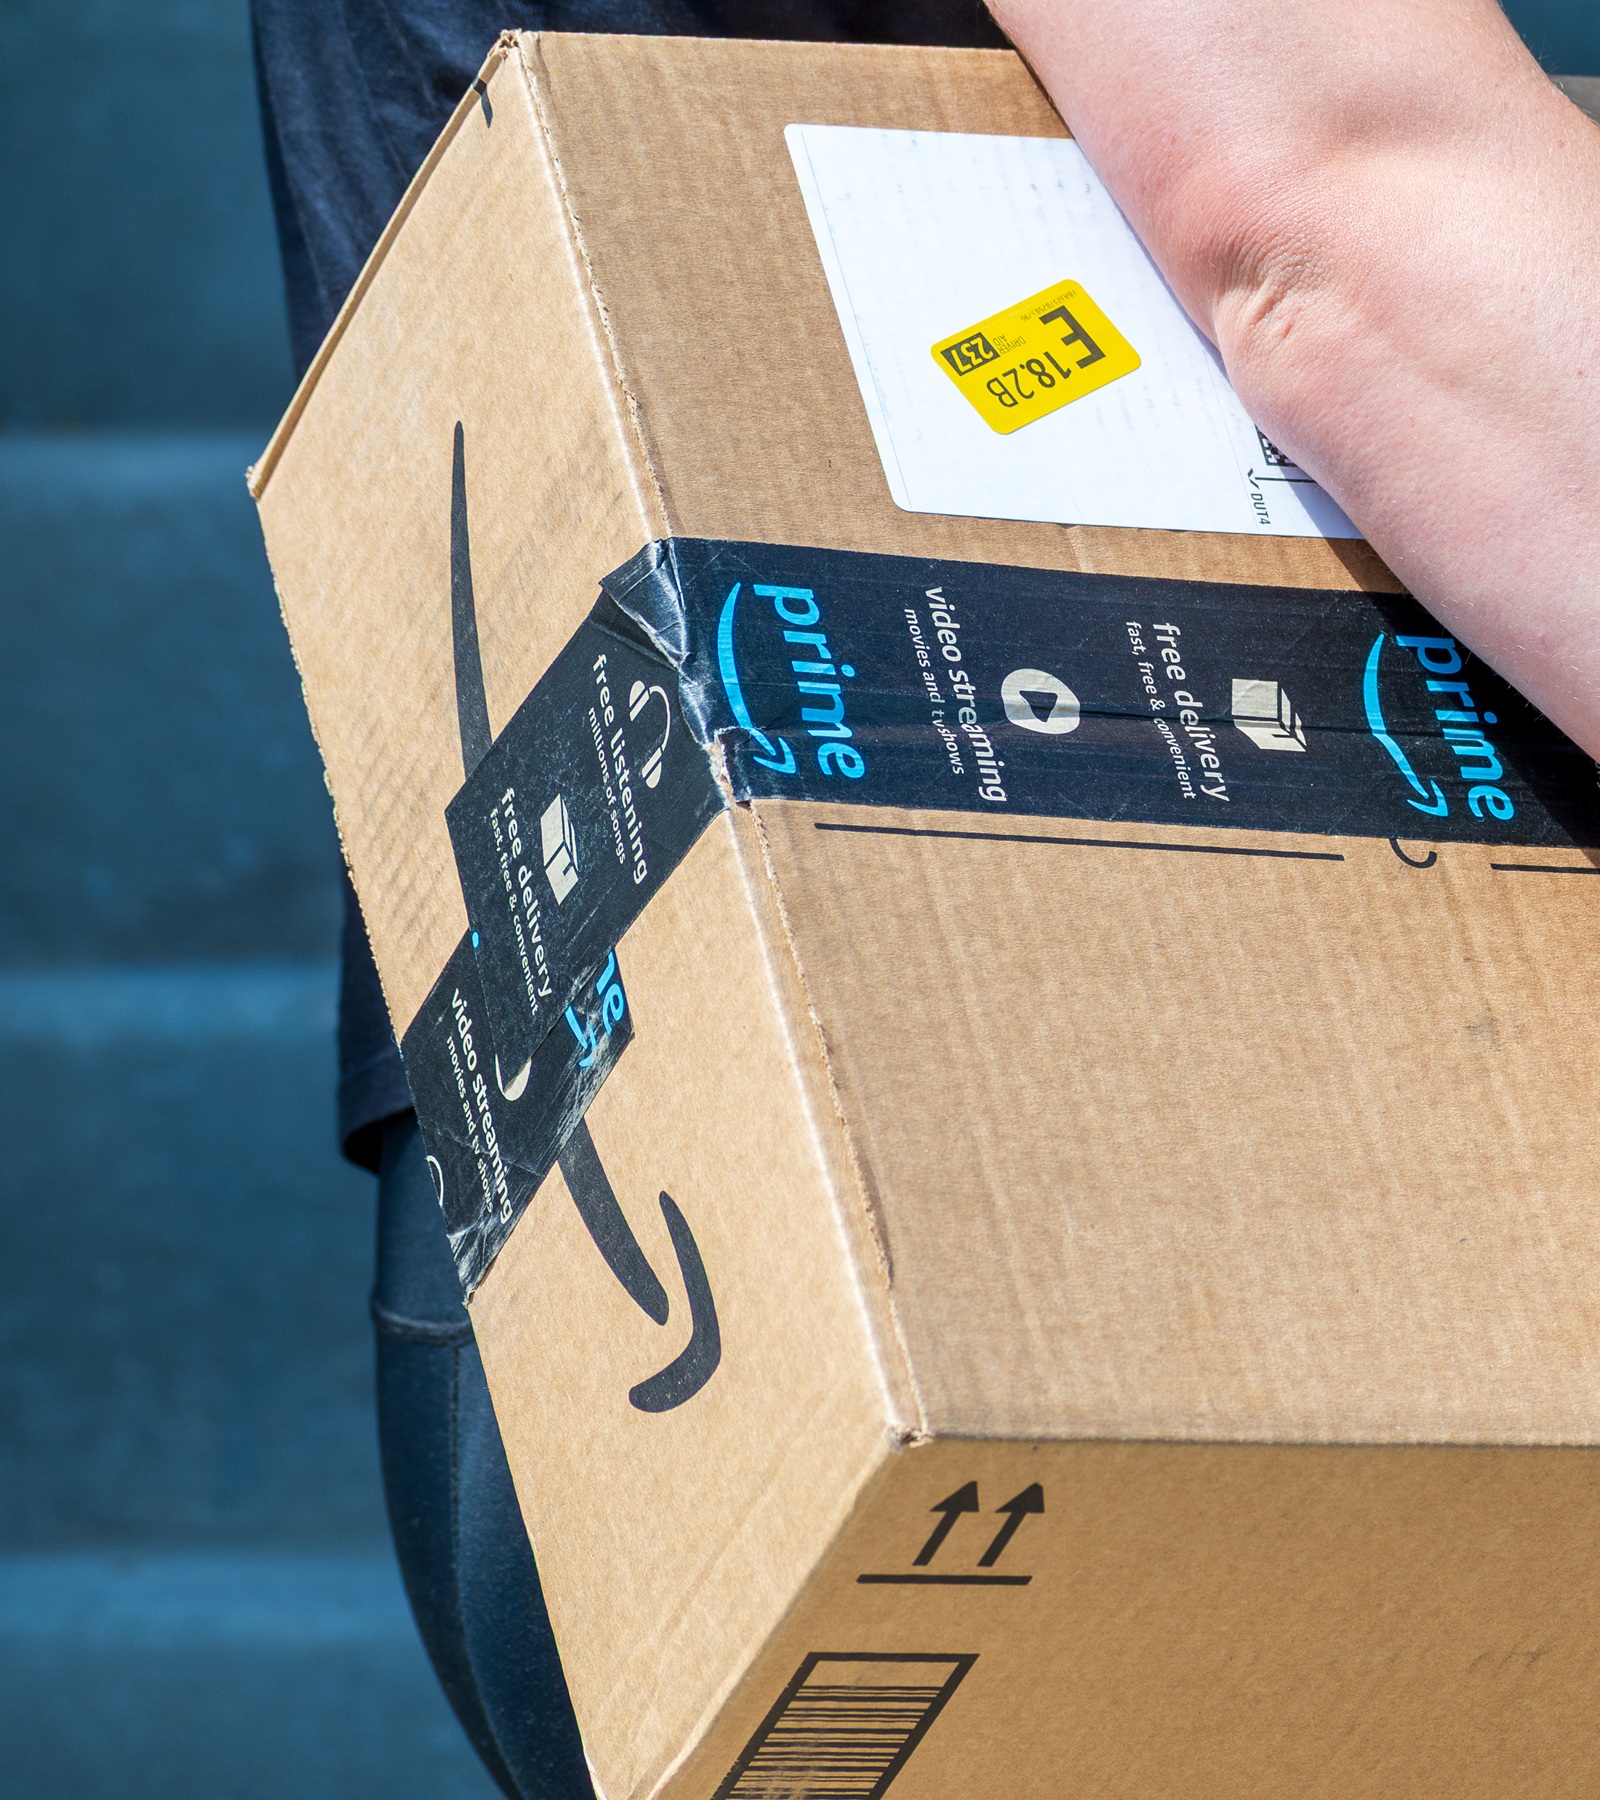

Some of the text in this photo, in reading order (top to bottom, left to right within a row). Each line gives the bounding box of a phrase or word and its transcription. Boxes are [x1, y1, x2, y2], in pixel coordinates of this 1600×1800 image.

[950, 336, 994, 373] 237
[986, 351, 1072, 408] 18.2B
[992, 334, 1006, 346] AID
[999, 336, 1027, 355] DRIVER
[1038, 305, 1106, 370] E
[1250, 493, 1271, 525] DUT4
[592, 654, 648, 884] free listening
[753, 584, 865, 779] prime
[904, 608, 965, 775] movies and tv shows
[925, 586, 1007, 801] video streaming
[1126, 621, 1197, 800] fast, free & convenient
[1153, 622, 1230, 802] free delivery
[1395, 635, 1515, 821] prime
[588, 707, 627, 864] millions of songs
[490, 808, 540, 1016] fast, free & convenient
[501, 787, 552, 997] free delivery
[446, 1036, 493, 1213] movies and tv shows
[451, 988, 514, 1224] video streaming
